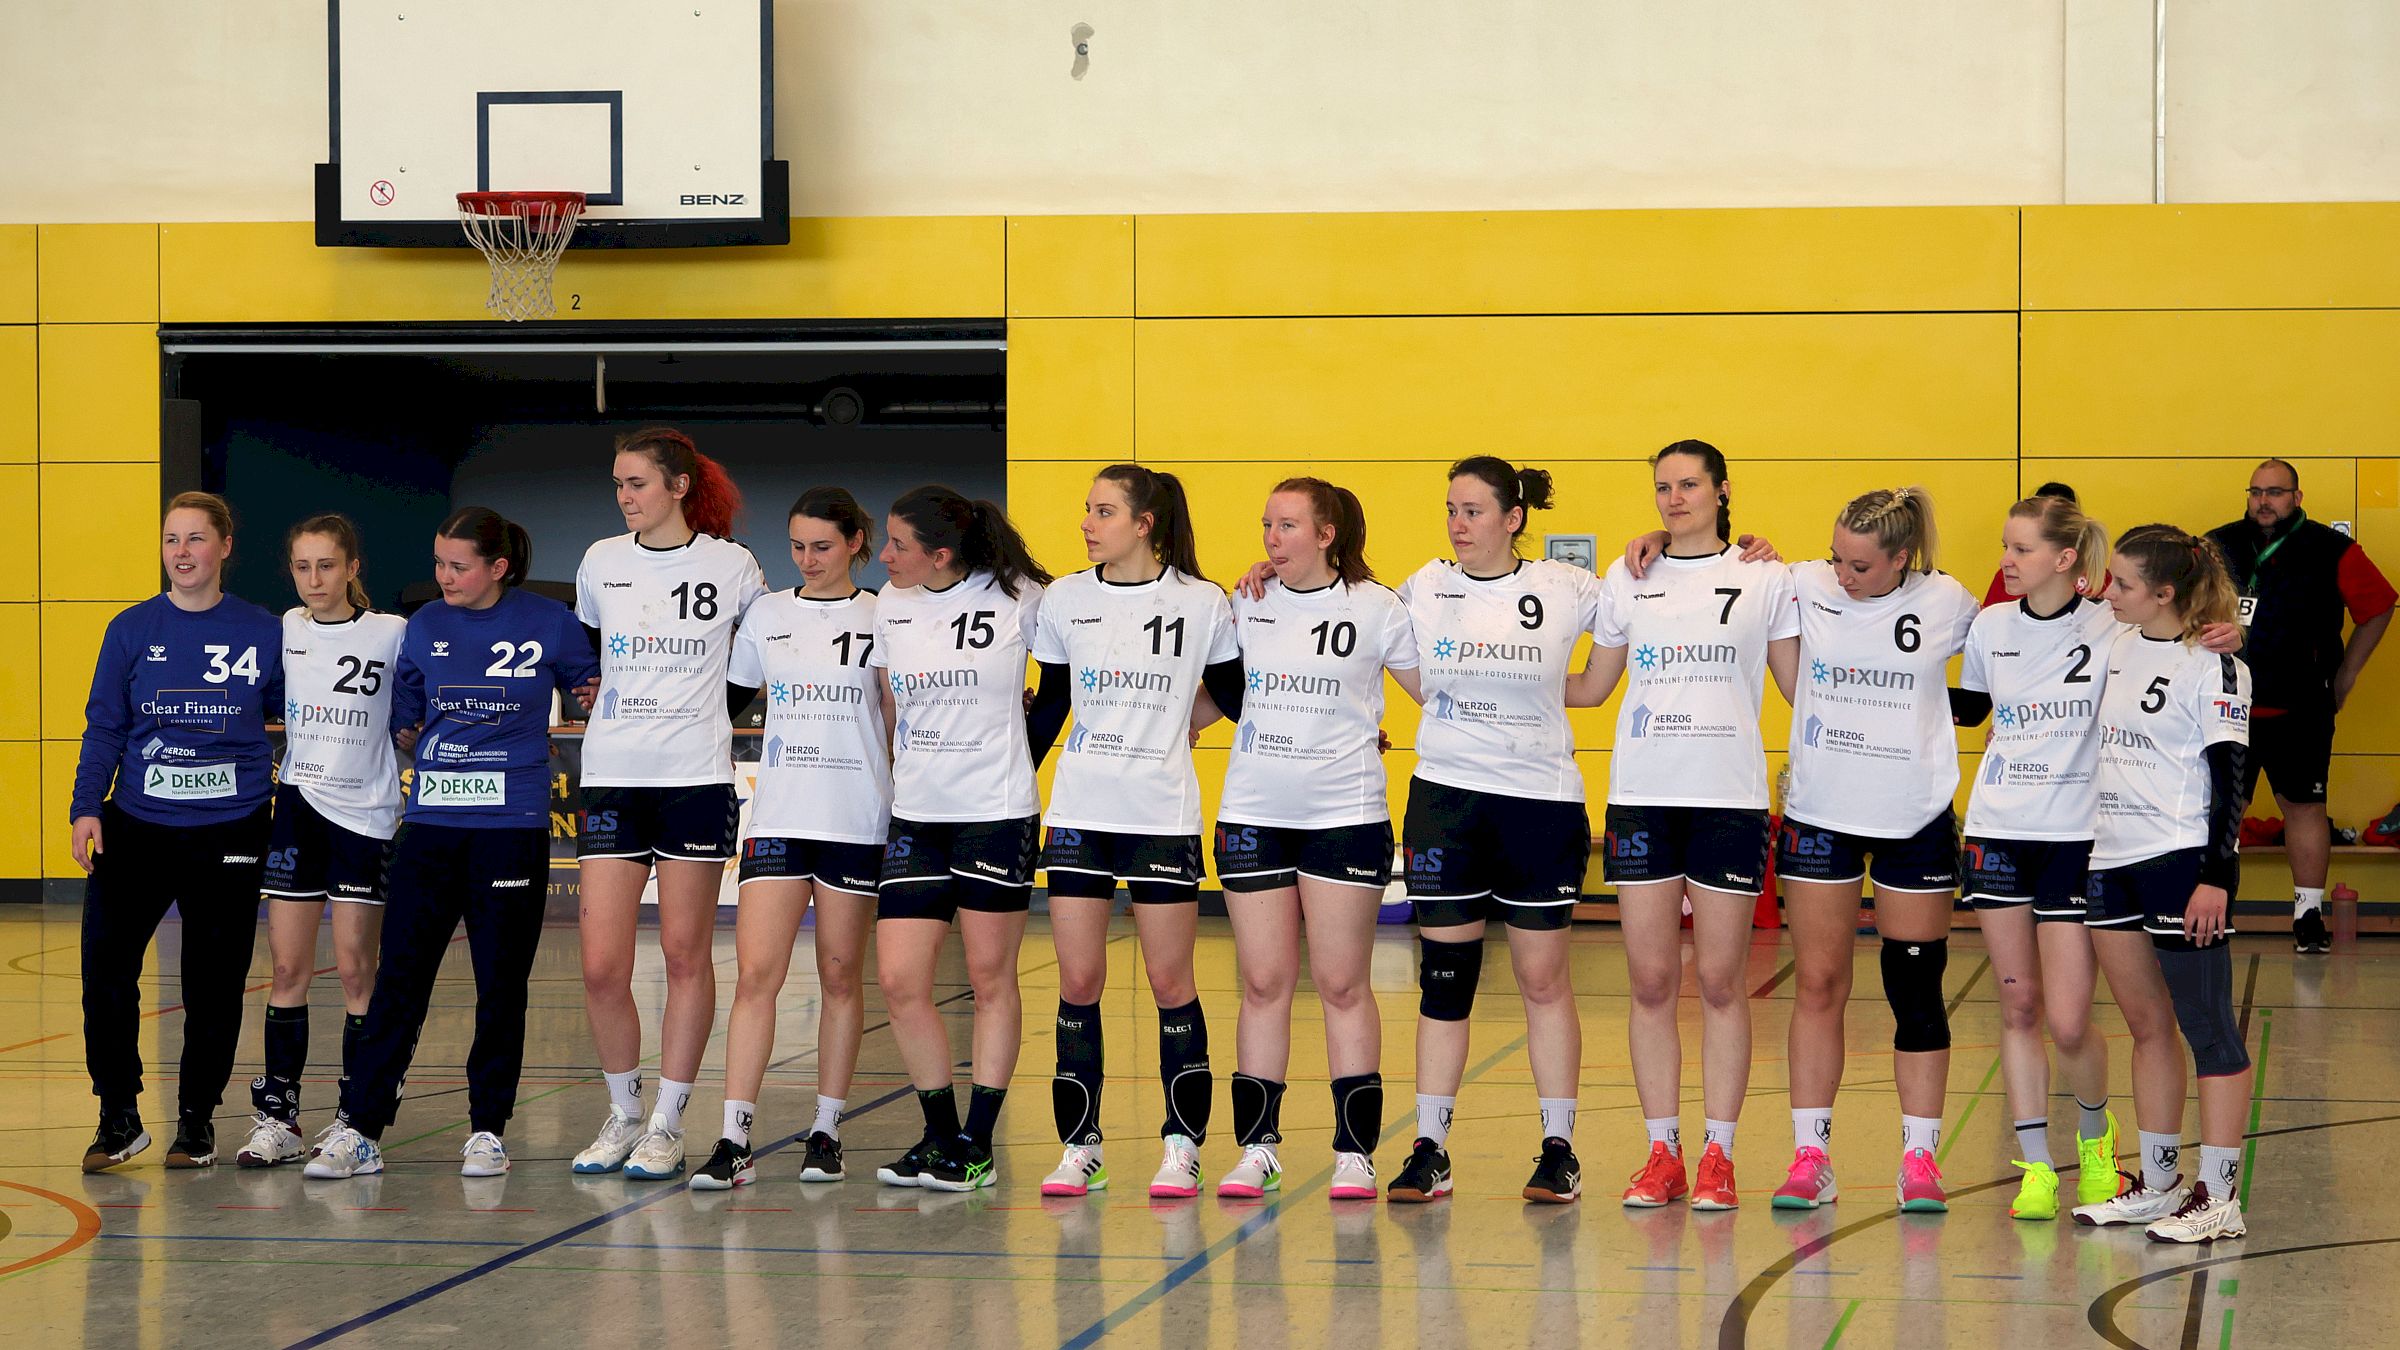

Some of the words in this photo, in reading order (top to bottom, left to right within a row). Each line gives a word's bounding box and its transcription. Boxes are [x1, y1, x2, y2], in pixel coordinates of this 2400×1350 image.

[680, 195, 744, 205] BENZ
[572, 295, 580, 310] 2
[671, 582, 718, 621] 18
[1714, 588, 1741, 625] 7
[2240, 599, 2253, 615] B
[1518, 594, 1543, 630] 9
[1818, 604, 1842, 616] hummel
[951, 611, 995, 649] 15
[1144, 616, 1185, 657] 11
[1894, 614, 1921, 653] 6
[1311, 620, 1357, 658] 10
[632, 636, 706, 659] pixum
[832, 631, 874, 668] 17
[1458, 642, 1541, 663] pixum
[203, 645, 260, 685] 34
[486, 641, 543, 677] 22
[1662, 645, 1736, 671] pixum
[2064, 644, 2091, 683] 2
[333, 655, 385, 696] 25
[905, 669, 977, 696] pixum
[1099, 670, 1171, 693] pixum
[1448, 669, 1541, 681] ONLINE-FOTOSERVICE
[1833, 667, 1915, 690] pixum
[1265, 673, 1340, 696] pixum
[622, 698, 658, 706] HERZOG
[792, 683, 863, 707] pixum
[1825, 694, 1911, 710] ONLINE-FOTOSERVICE
[2140, 676, 2171, 714] 5
[141, 701, 179, 715] Clear
[184, 702, 241, 715] Finance
[431, 698, 460, 711] Clear
[464, 698, 520, 712] Finance
[1458, 701, 1497, 711] HERZOG
[301, 704, 368, 727] pixum
[1655, 715, 1691, 723] HERZOG
[2017, 699, 2093, 729] pixum
[912, 730, 940, 739] HERZOG
[1091, 733, 1123, 743] HERZOG
[1259, 733, 1293, 744] HERZOG
[1827, 728, 1864, 742] HERZOG
[163, 747, 196, 756] HERZOG
[439, 743, 468, 752] HERZOG
[786, 745, 820, 754] HERZOG
[295, 762, 324, 772] HERZOG
[2010, 763, 2048, 772] HERZOG
[172, 770, 230, 788] DEKRA
[441, 779, 497, 794] DEKRA
[266, 848, 298, 871] eS
[983, 863, 1008, 875] hummel
[1157, 865, 1181, 874] hummel
[347, 885, 371, 893] hummel
[492, 879, 530, 888] HUMMEL
[851, 877, 875, 886] hummel
[1164, 1024, 1191, 1033] SELECT
